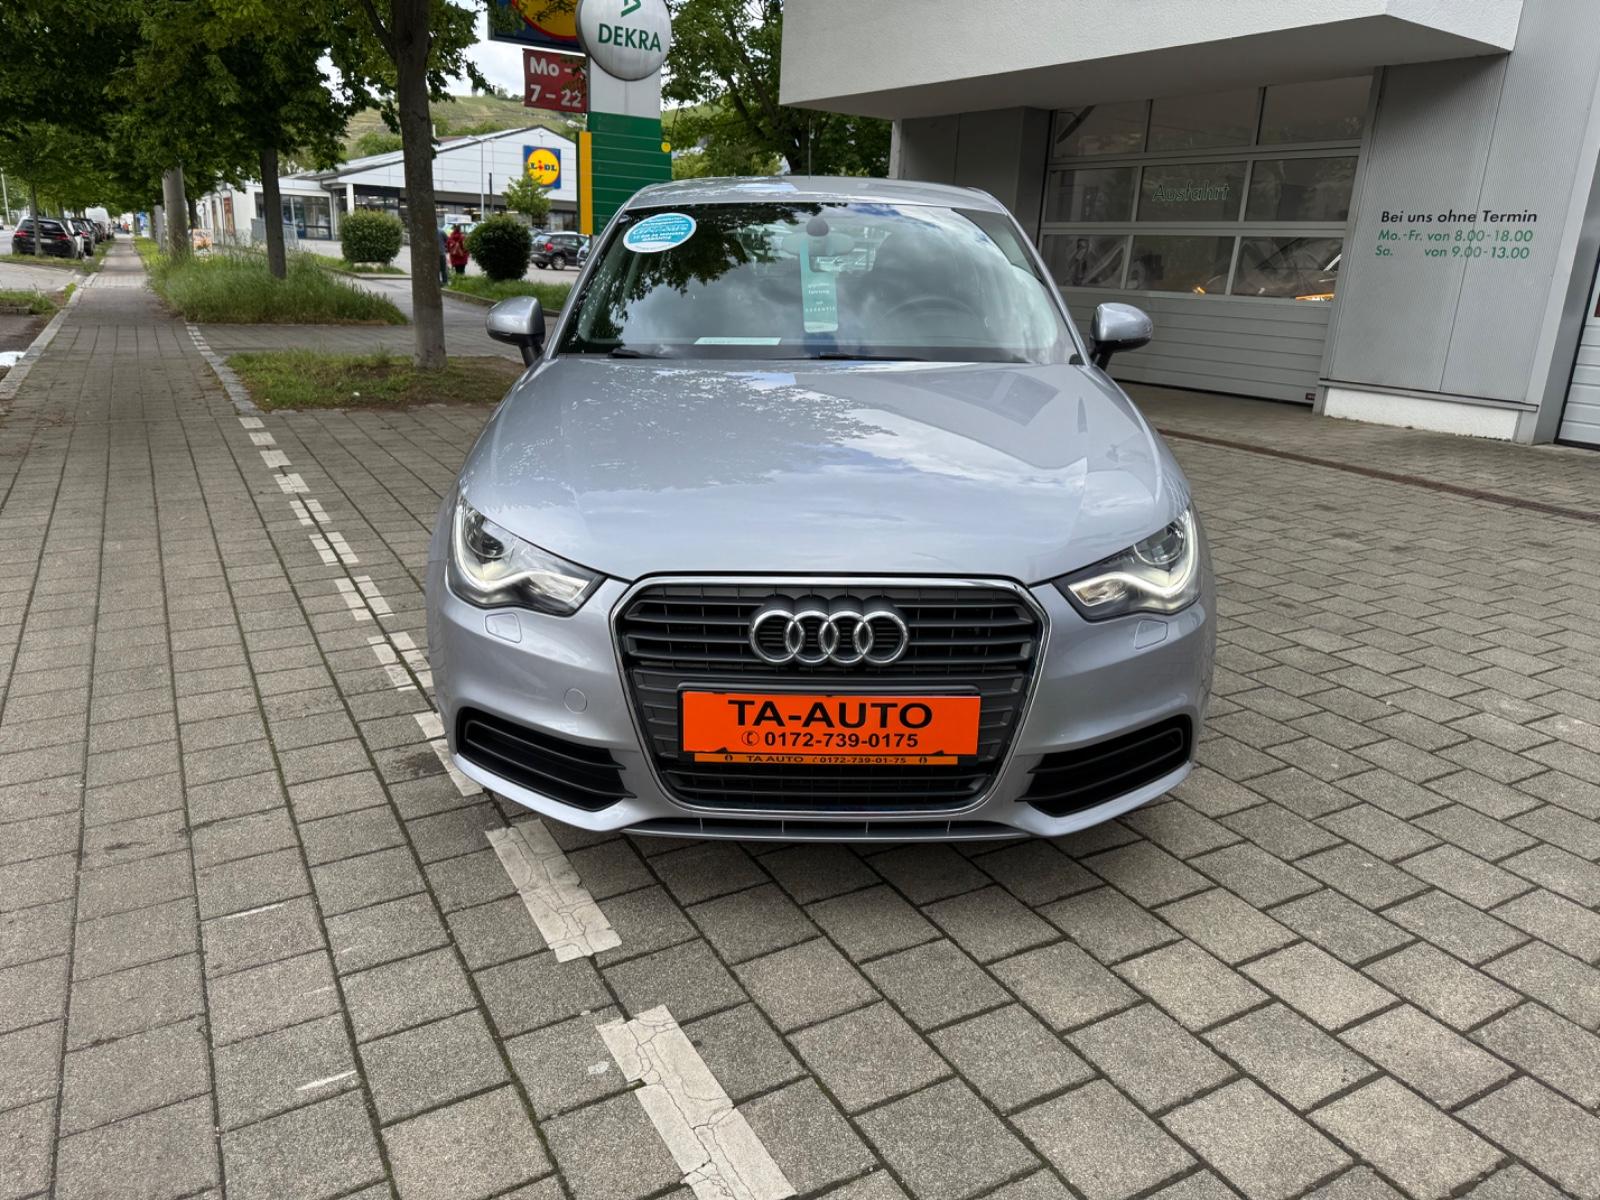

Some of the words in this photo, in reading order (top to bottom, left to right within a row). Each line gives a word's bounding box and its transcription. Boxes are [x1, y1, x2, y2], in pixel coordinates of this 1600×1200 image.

[598, 23, 661, 52] DEKRA
[530, 56, 560, 77] Mo
[530, 84, 542, 102] 7
[560, 90, 582, 108] 22
[1381, 210, 1404, 223] Bei
[1407, 214, 1433, 223] uns
[1437, 209, 1477, 223] ohne
[1482, 209, 1538, 223] Termin
[1427, 232, 1450, 242] von
[1375, 244, 1394, 257] Sa.
[1424, 248, 1448, 257] von
[728, 699, 933, 729] TA-AUTO
[764, 731, 919, 748] 0172-739-0175
